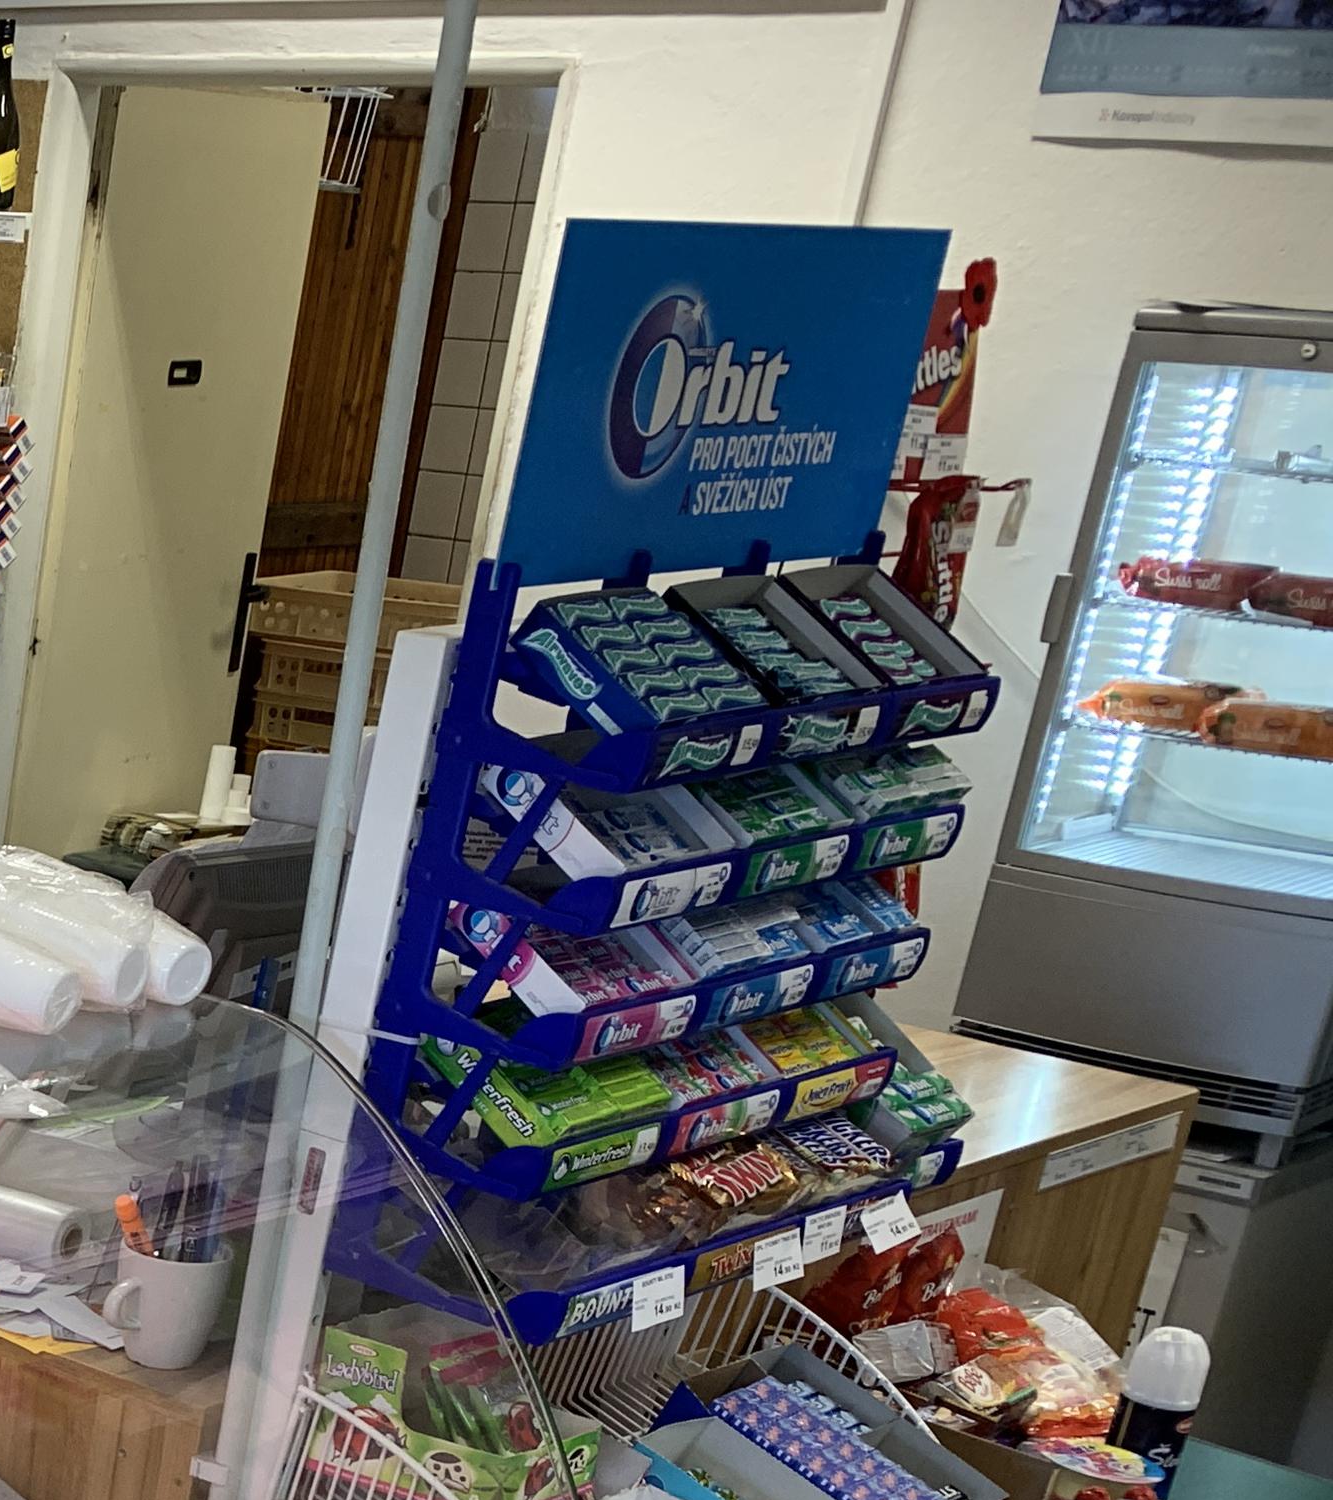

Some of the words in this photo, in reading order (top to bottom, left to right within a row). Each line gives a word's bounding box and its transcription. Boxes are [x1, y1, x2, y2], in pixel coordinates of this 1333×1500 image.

[620, 322, 790, 445] Orbit
[691, 436, 722, 471] PRO
[724, 433, 772, 470] POCIT
[774, 424, 836, 465] ČISTÝCH
[679, 486, 691, 515] A
[692, 473, 759, 516] SVĚŽÍCH
[760, 470, 793, 510] ÚST
[1154, 568, 1192, 589] Swiss
[1196, 573, 1221, 591] roll
[522, 628, 599, 700] Airwaves
[729, 990, 761, 1015] Orbit
[599, 1022, 642, 1048] Orbit
[570, 1144, 632, 1171] Winterfresh
[571, 1285, 634, 1324] BOUNT
[325, 1353, 402, 1395] Ladybird
